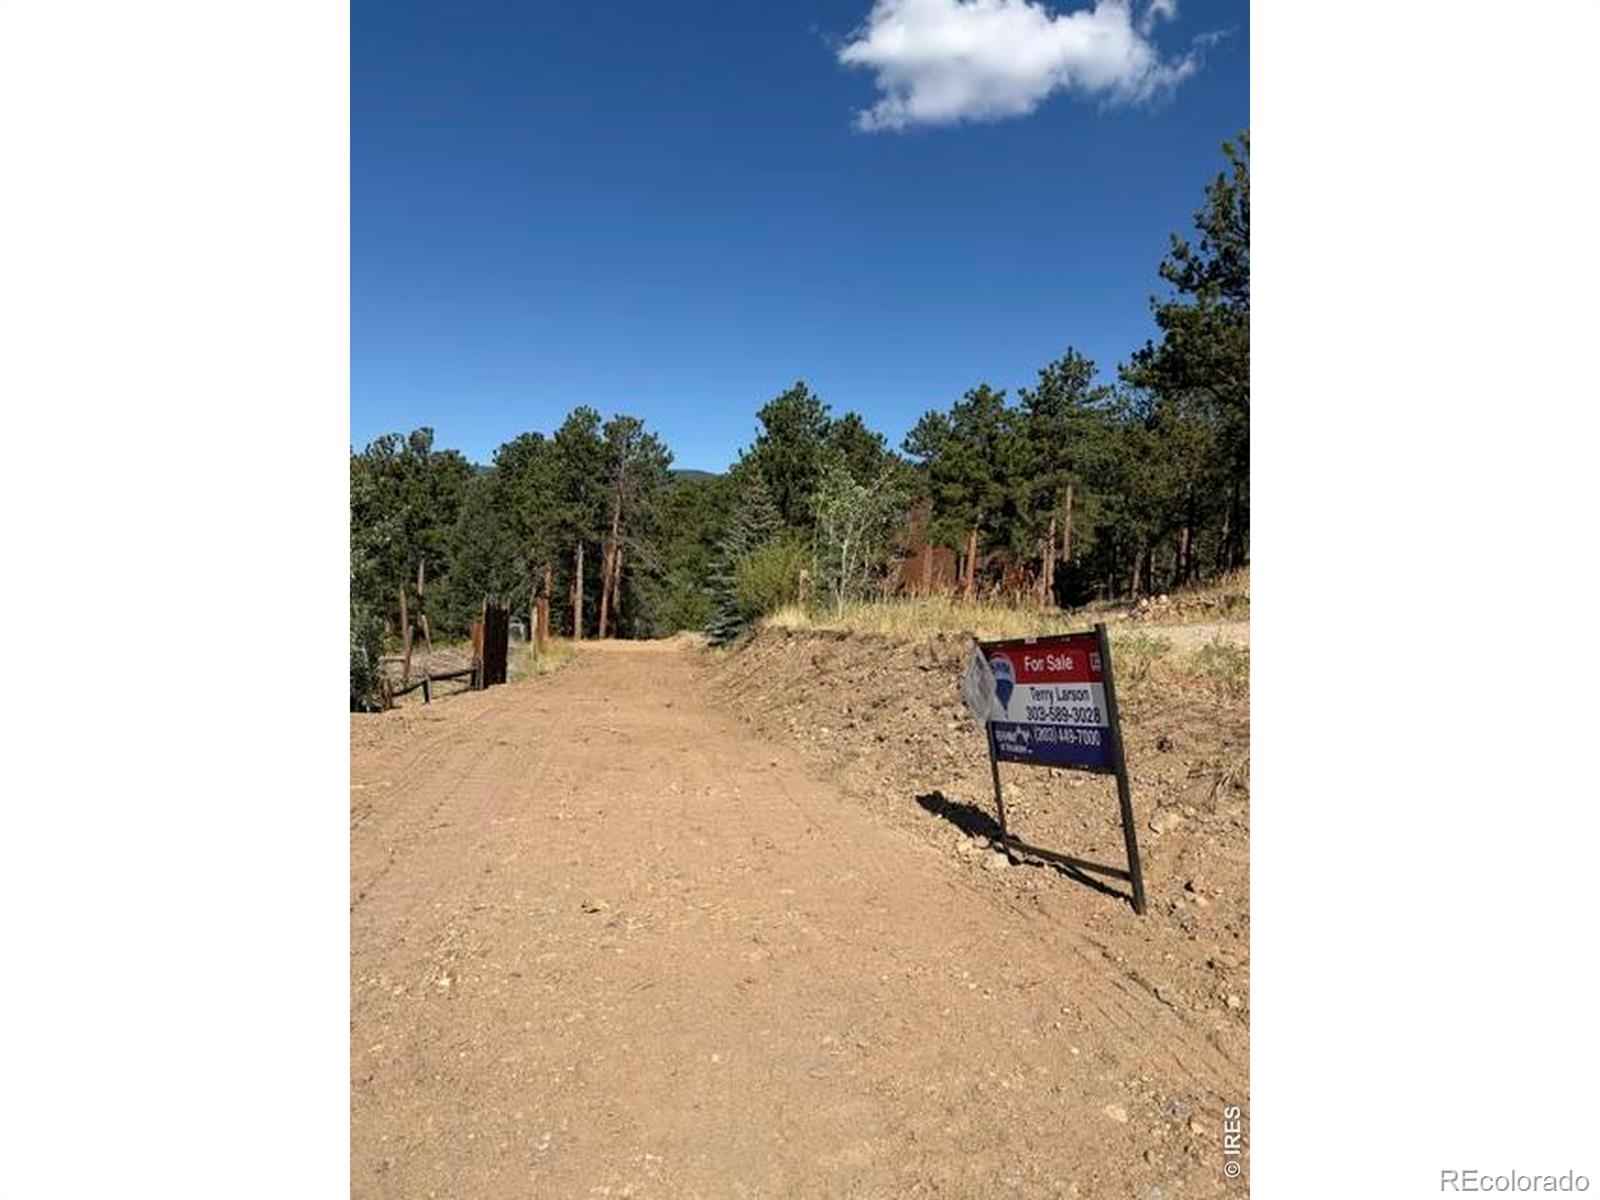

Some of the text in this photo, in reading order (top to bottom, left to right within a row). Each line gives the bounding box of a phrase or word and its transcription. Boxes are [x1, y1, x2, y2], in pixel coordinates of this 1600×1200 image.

[1024, 656, 1044, 671] For
[1046, 654, 1073, 671] Sale
[1030, 687, 1090, 705] Terry Larson
